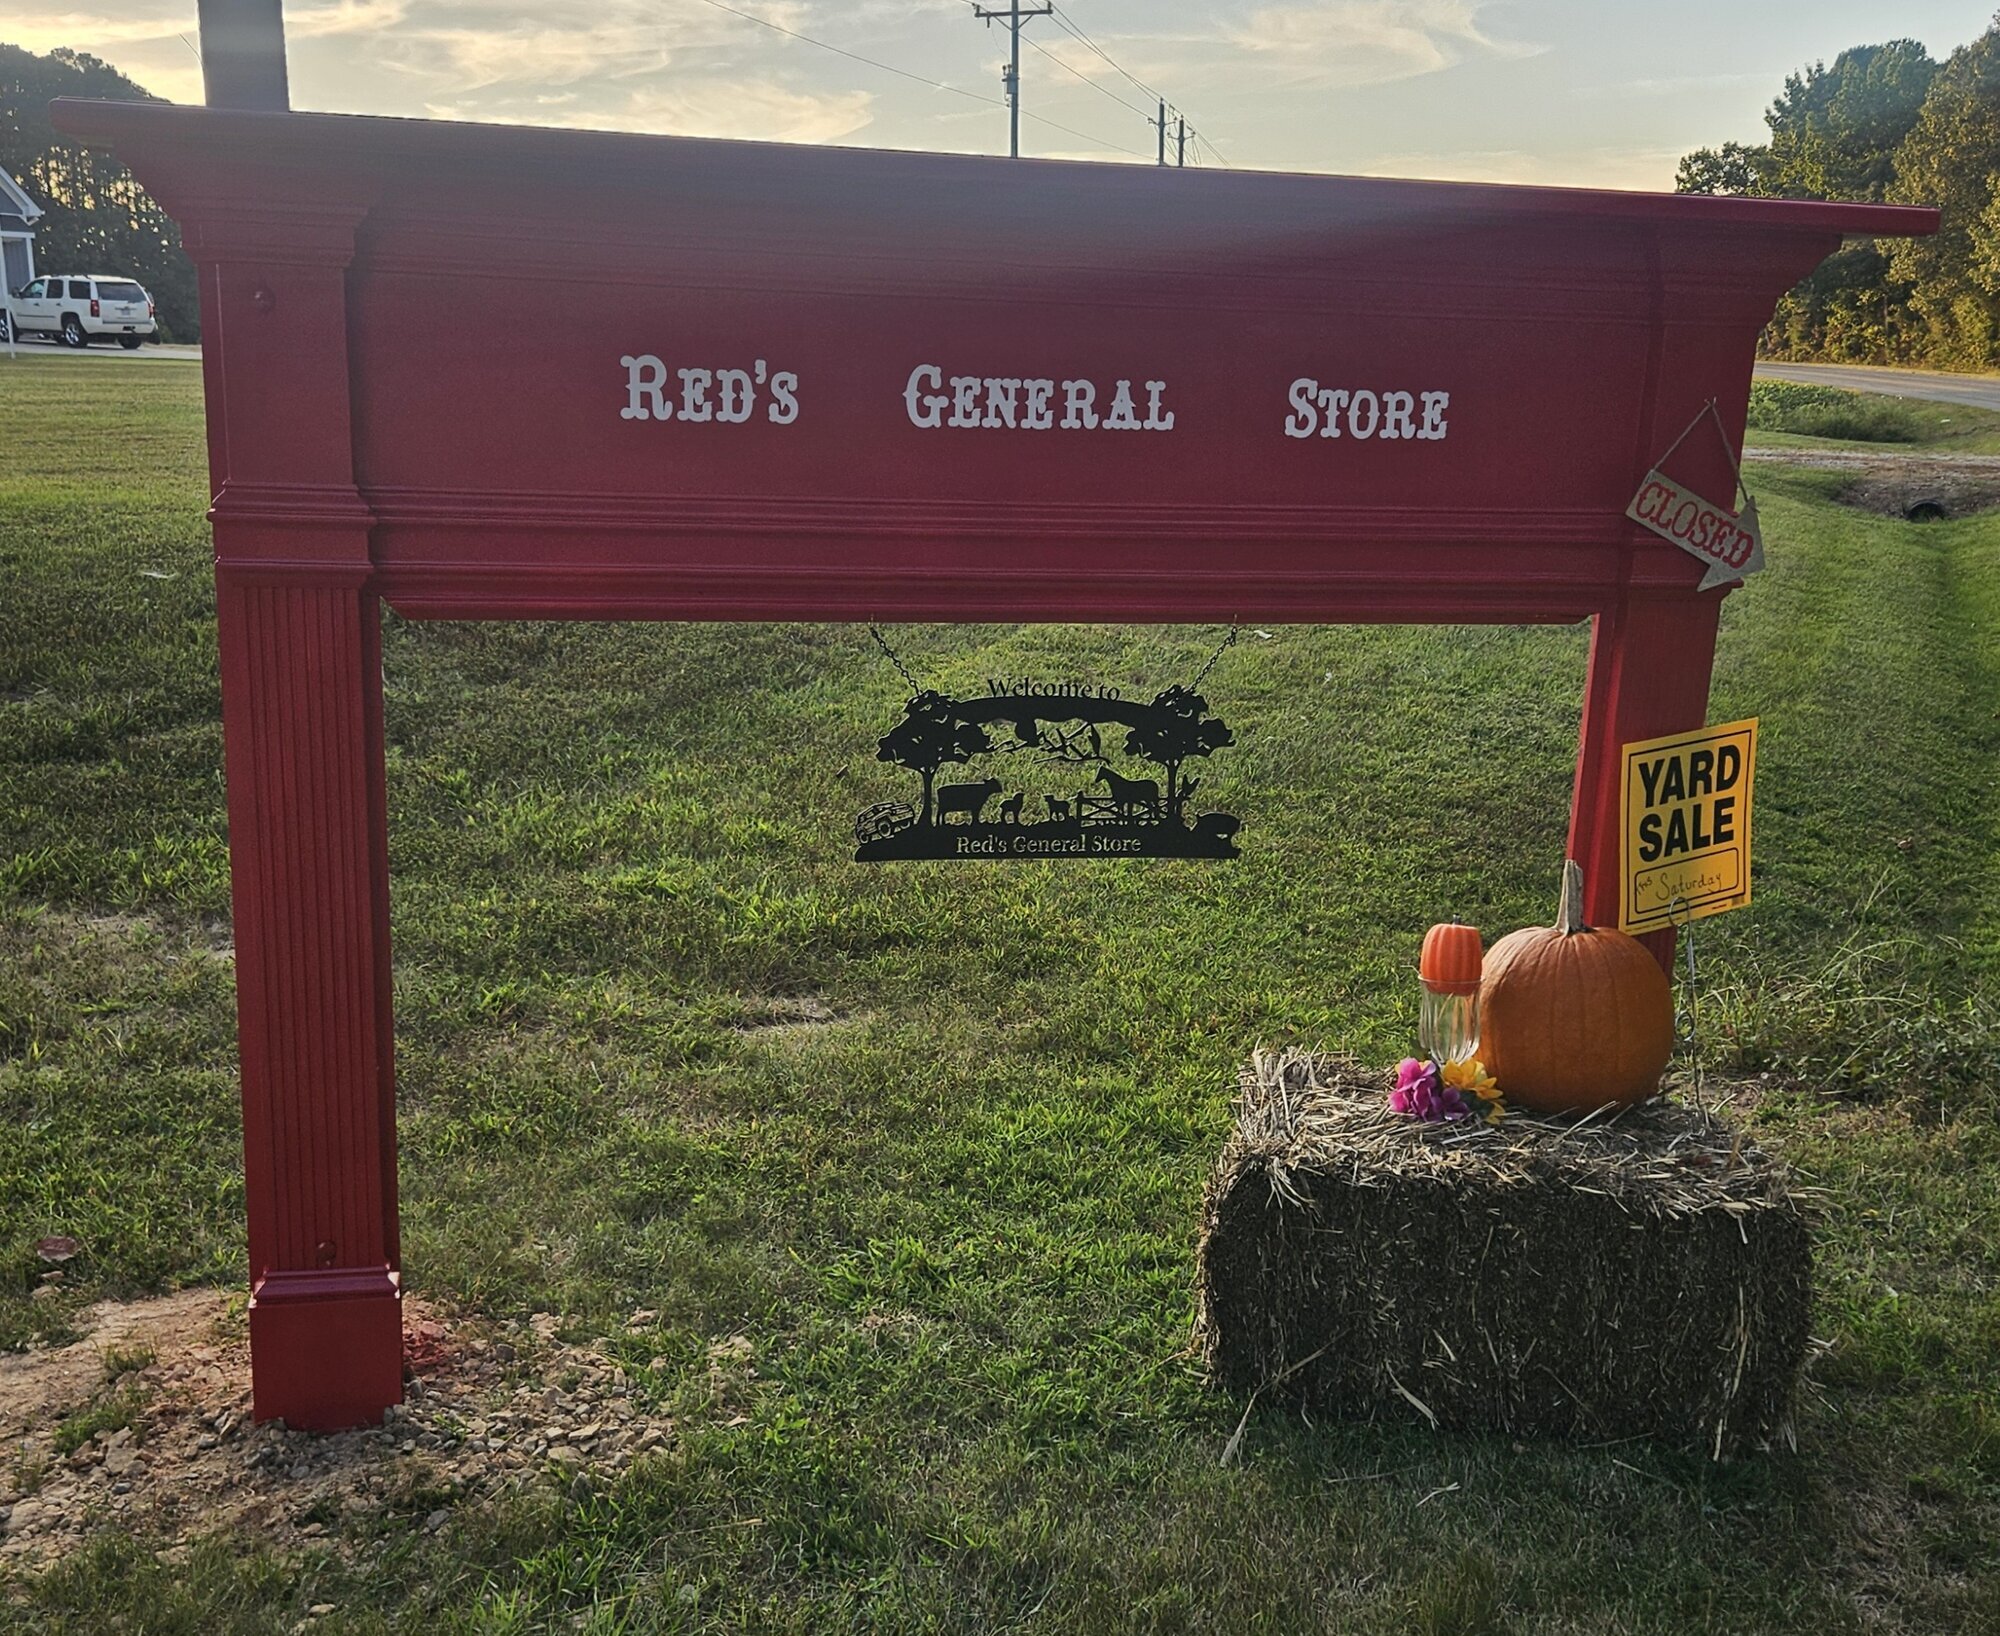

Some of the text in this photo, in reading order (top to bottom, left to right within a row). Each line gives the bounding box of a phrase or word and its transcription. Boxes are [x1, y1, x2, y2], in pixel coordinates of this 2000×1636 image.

[620, 354, 1451, 441] RED'S GENERAL STORE
[1635, 480, 1754, 569] CLOSED
[987, 676, 1120, 701] Welcome to
[1638, 744, 1741, 808] YARD
[956, 834, 1142, 853] Red's General Store
[1639, 796, 1735, 863] SALE
[1655, 872, 1722, 901] Saturday
